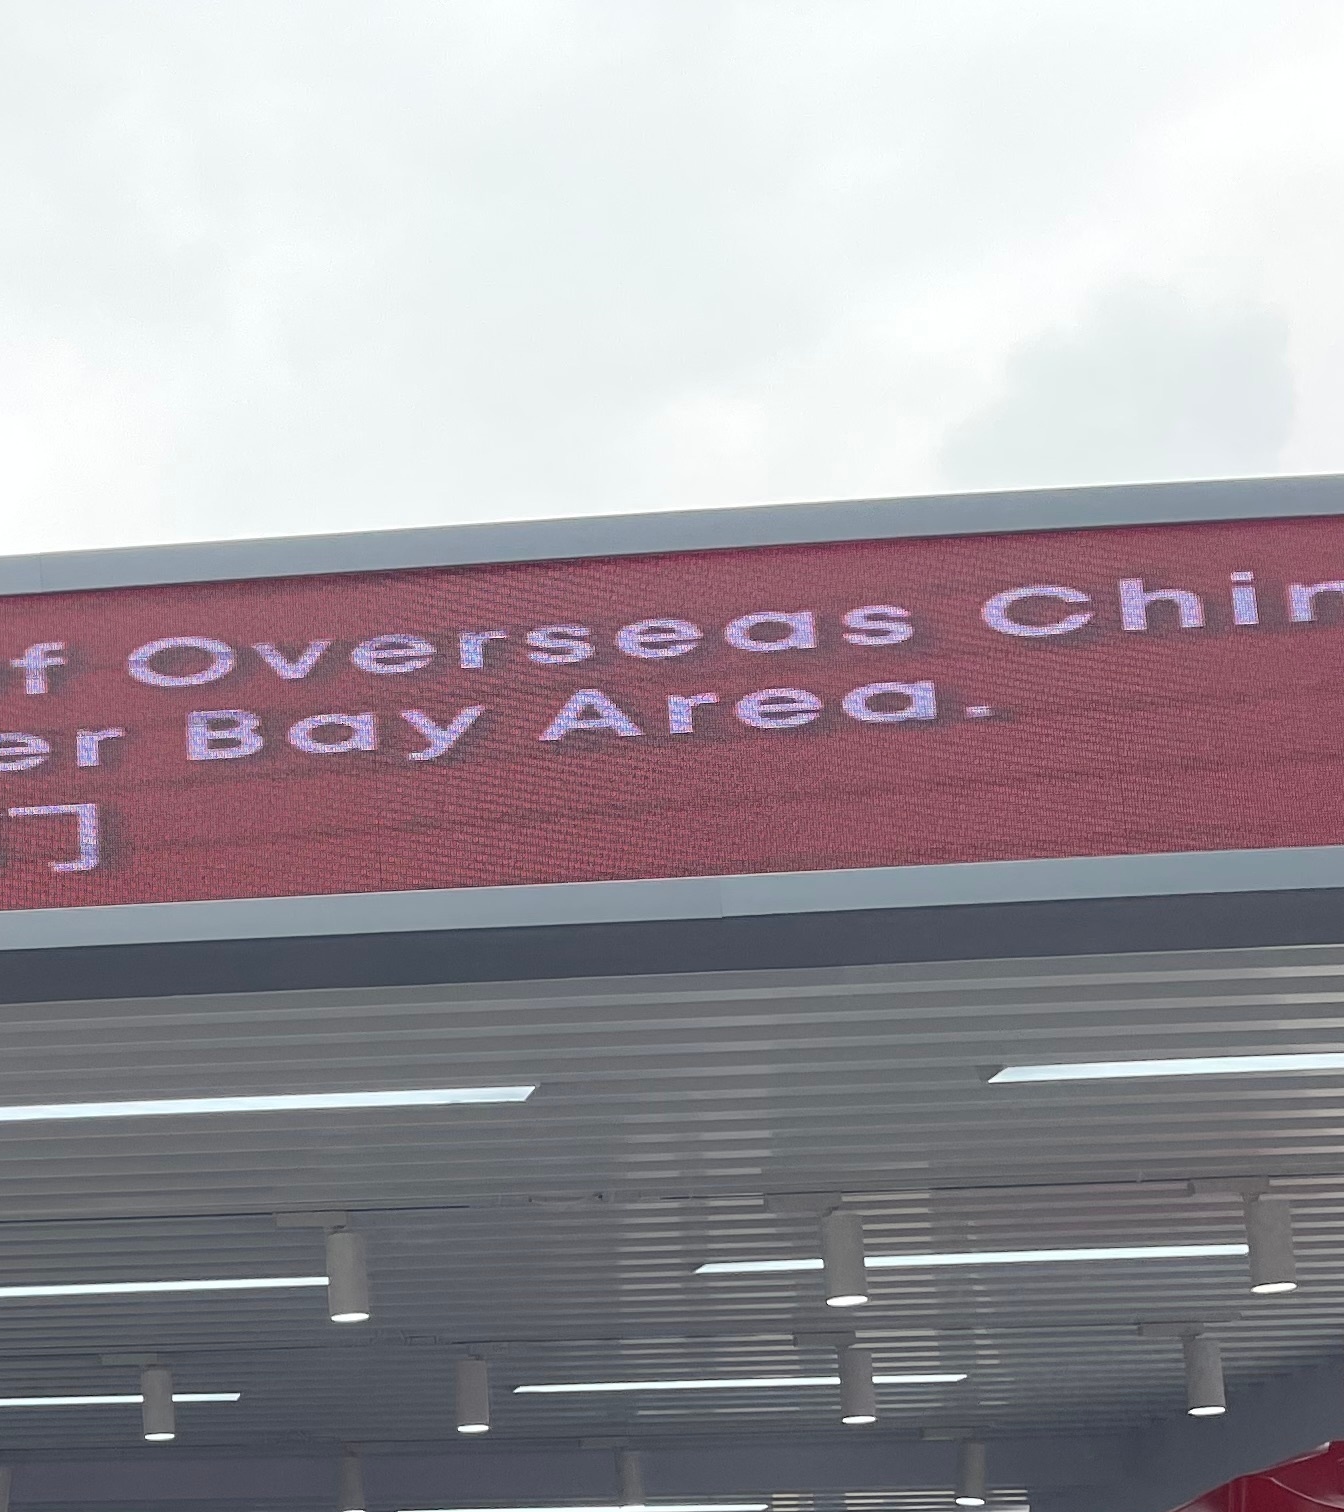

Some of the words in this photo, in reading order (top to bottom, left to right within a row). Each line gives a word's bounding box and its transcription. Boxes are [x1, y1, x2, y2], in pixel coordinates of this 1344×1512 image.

[127, 604, 914, 688] Overseas
[980, 571, 1344, 638] Chin
[185, 705, 486, 761] Bay
[538, 680, 991, 741] Area.
